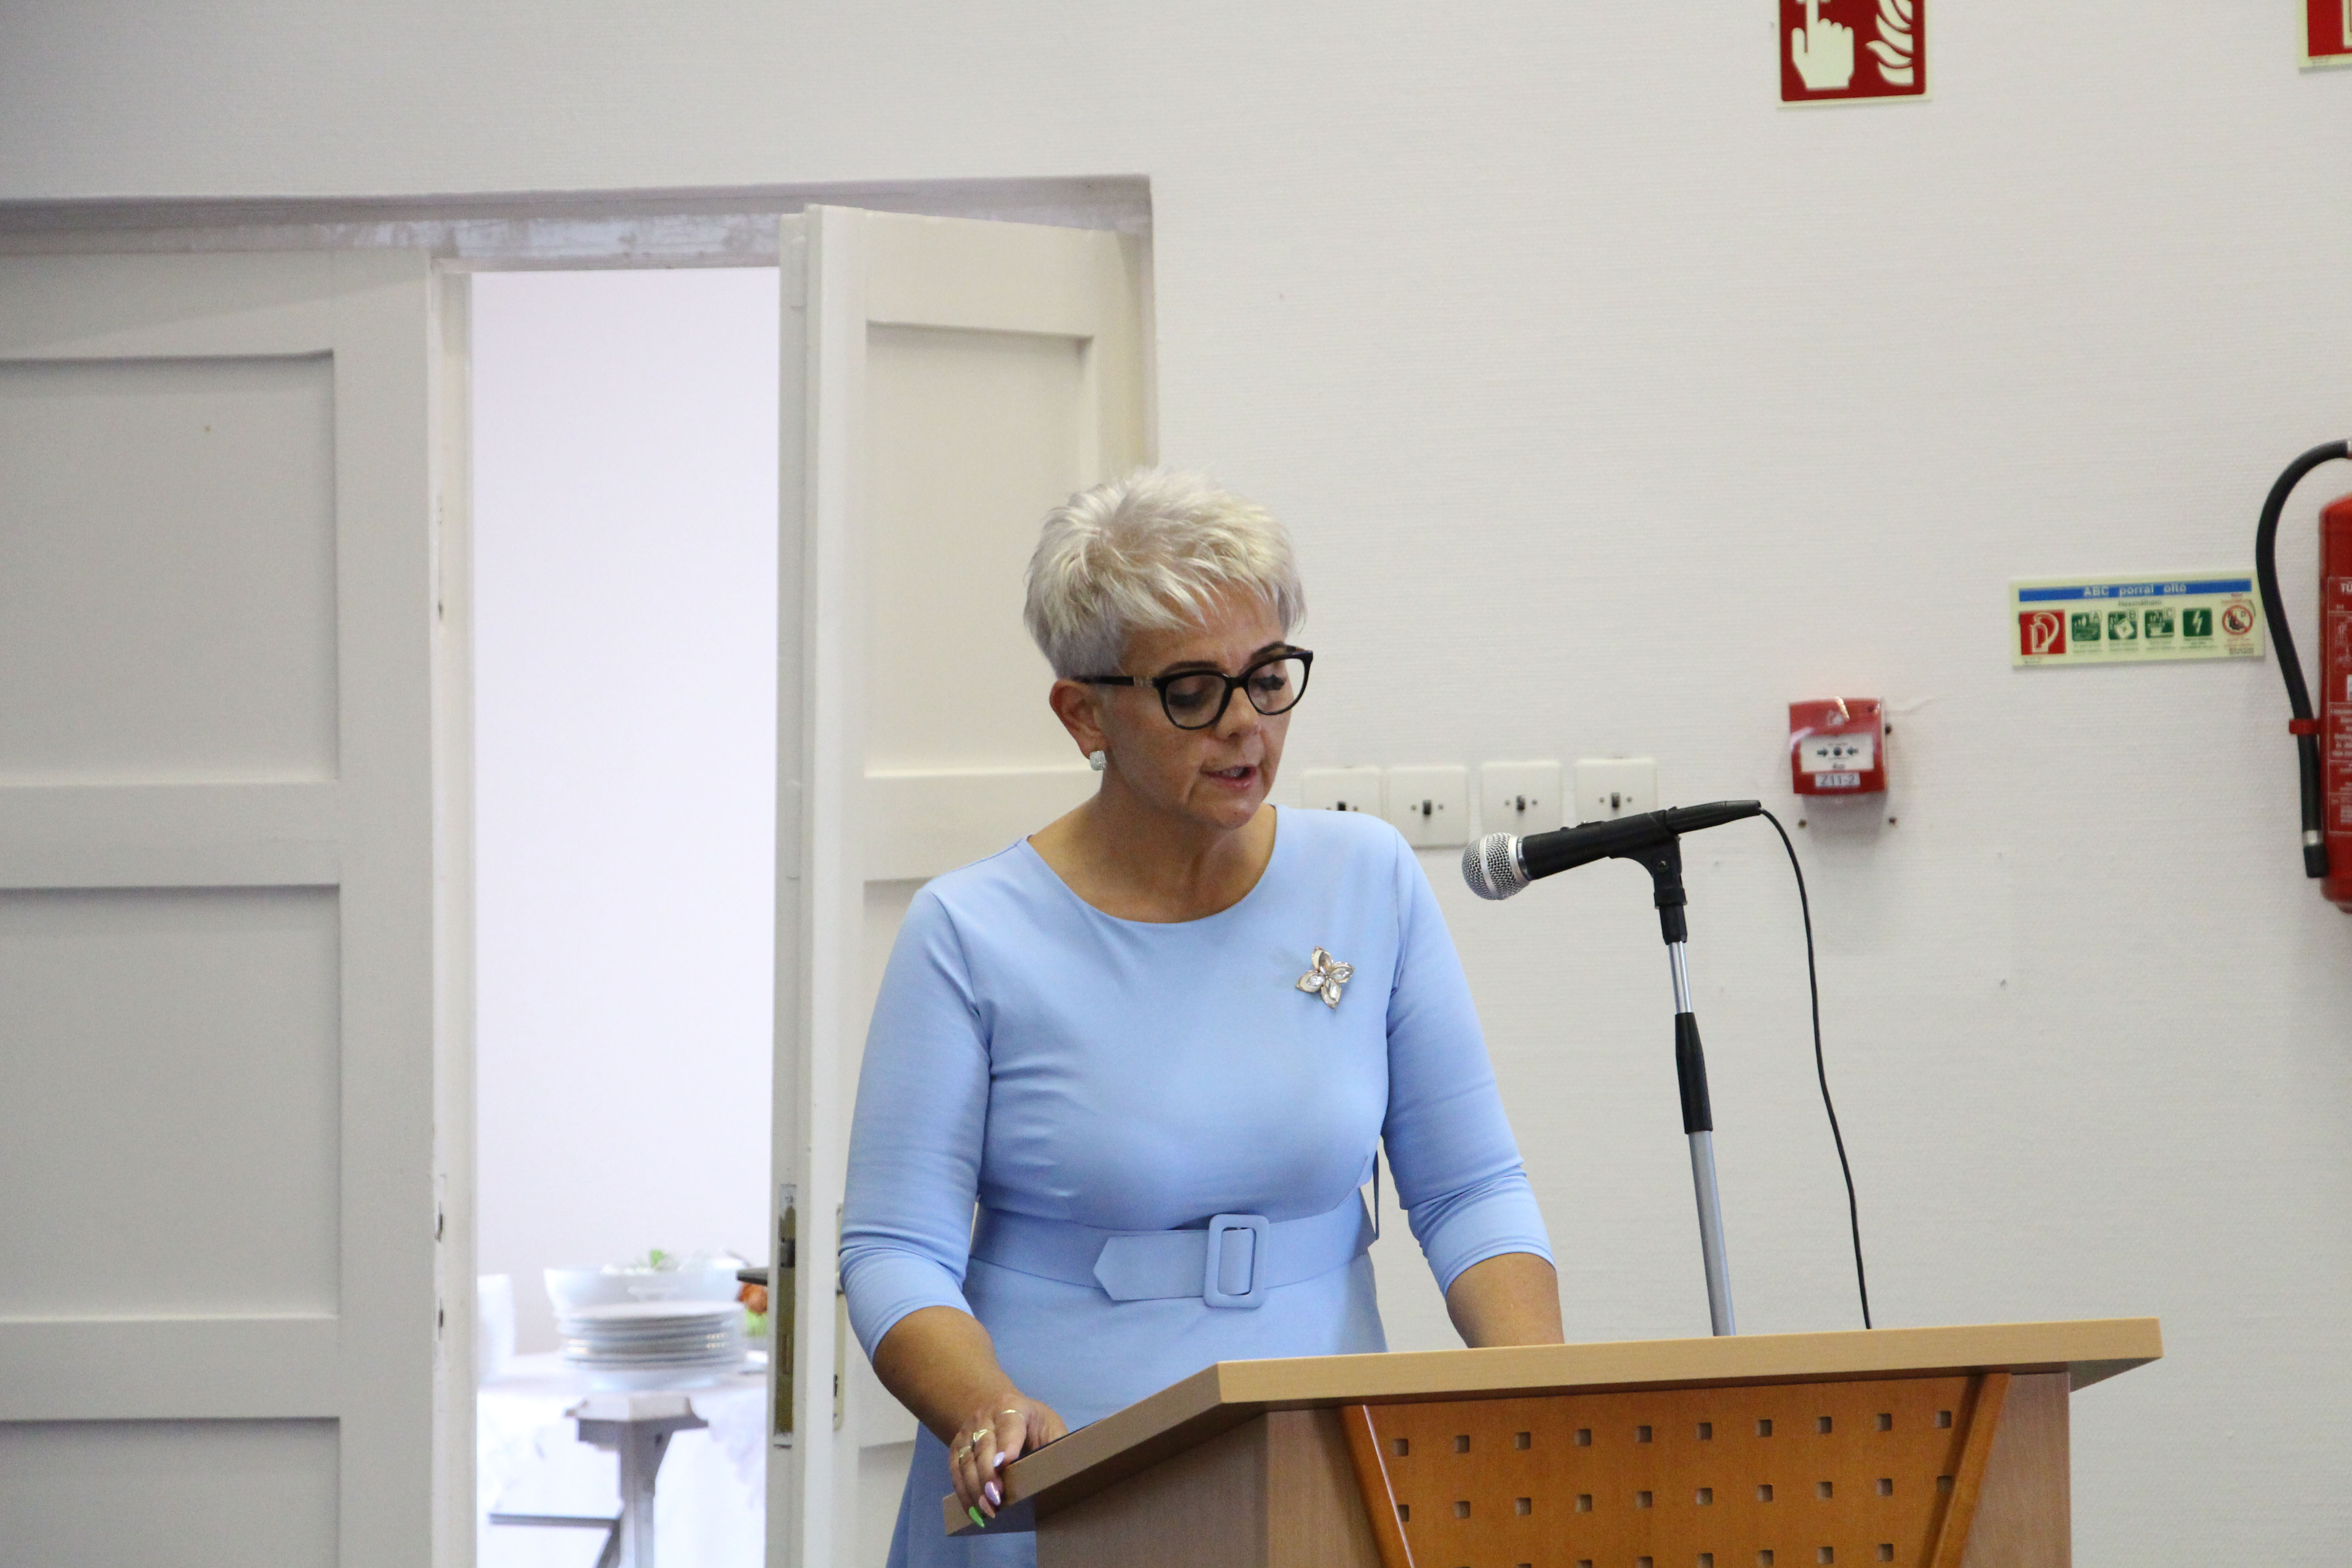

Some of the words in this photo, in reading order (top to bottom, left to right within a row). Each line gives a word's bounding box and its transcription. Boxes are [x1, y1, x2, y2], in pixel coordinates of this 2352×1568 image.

[2084, 586, 2109, 596] ABC
[2119, 584, 2154, 597] porral
[1821, 774, 1855, 787] Z11-2
